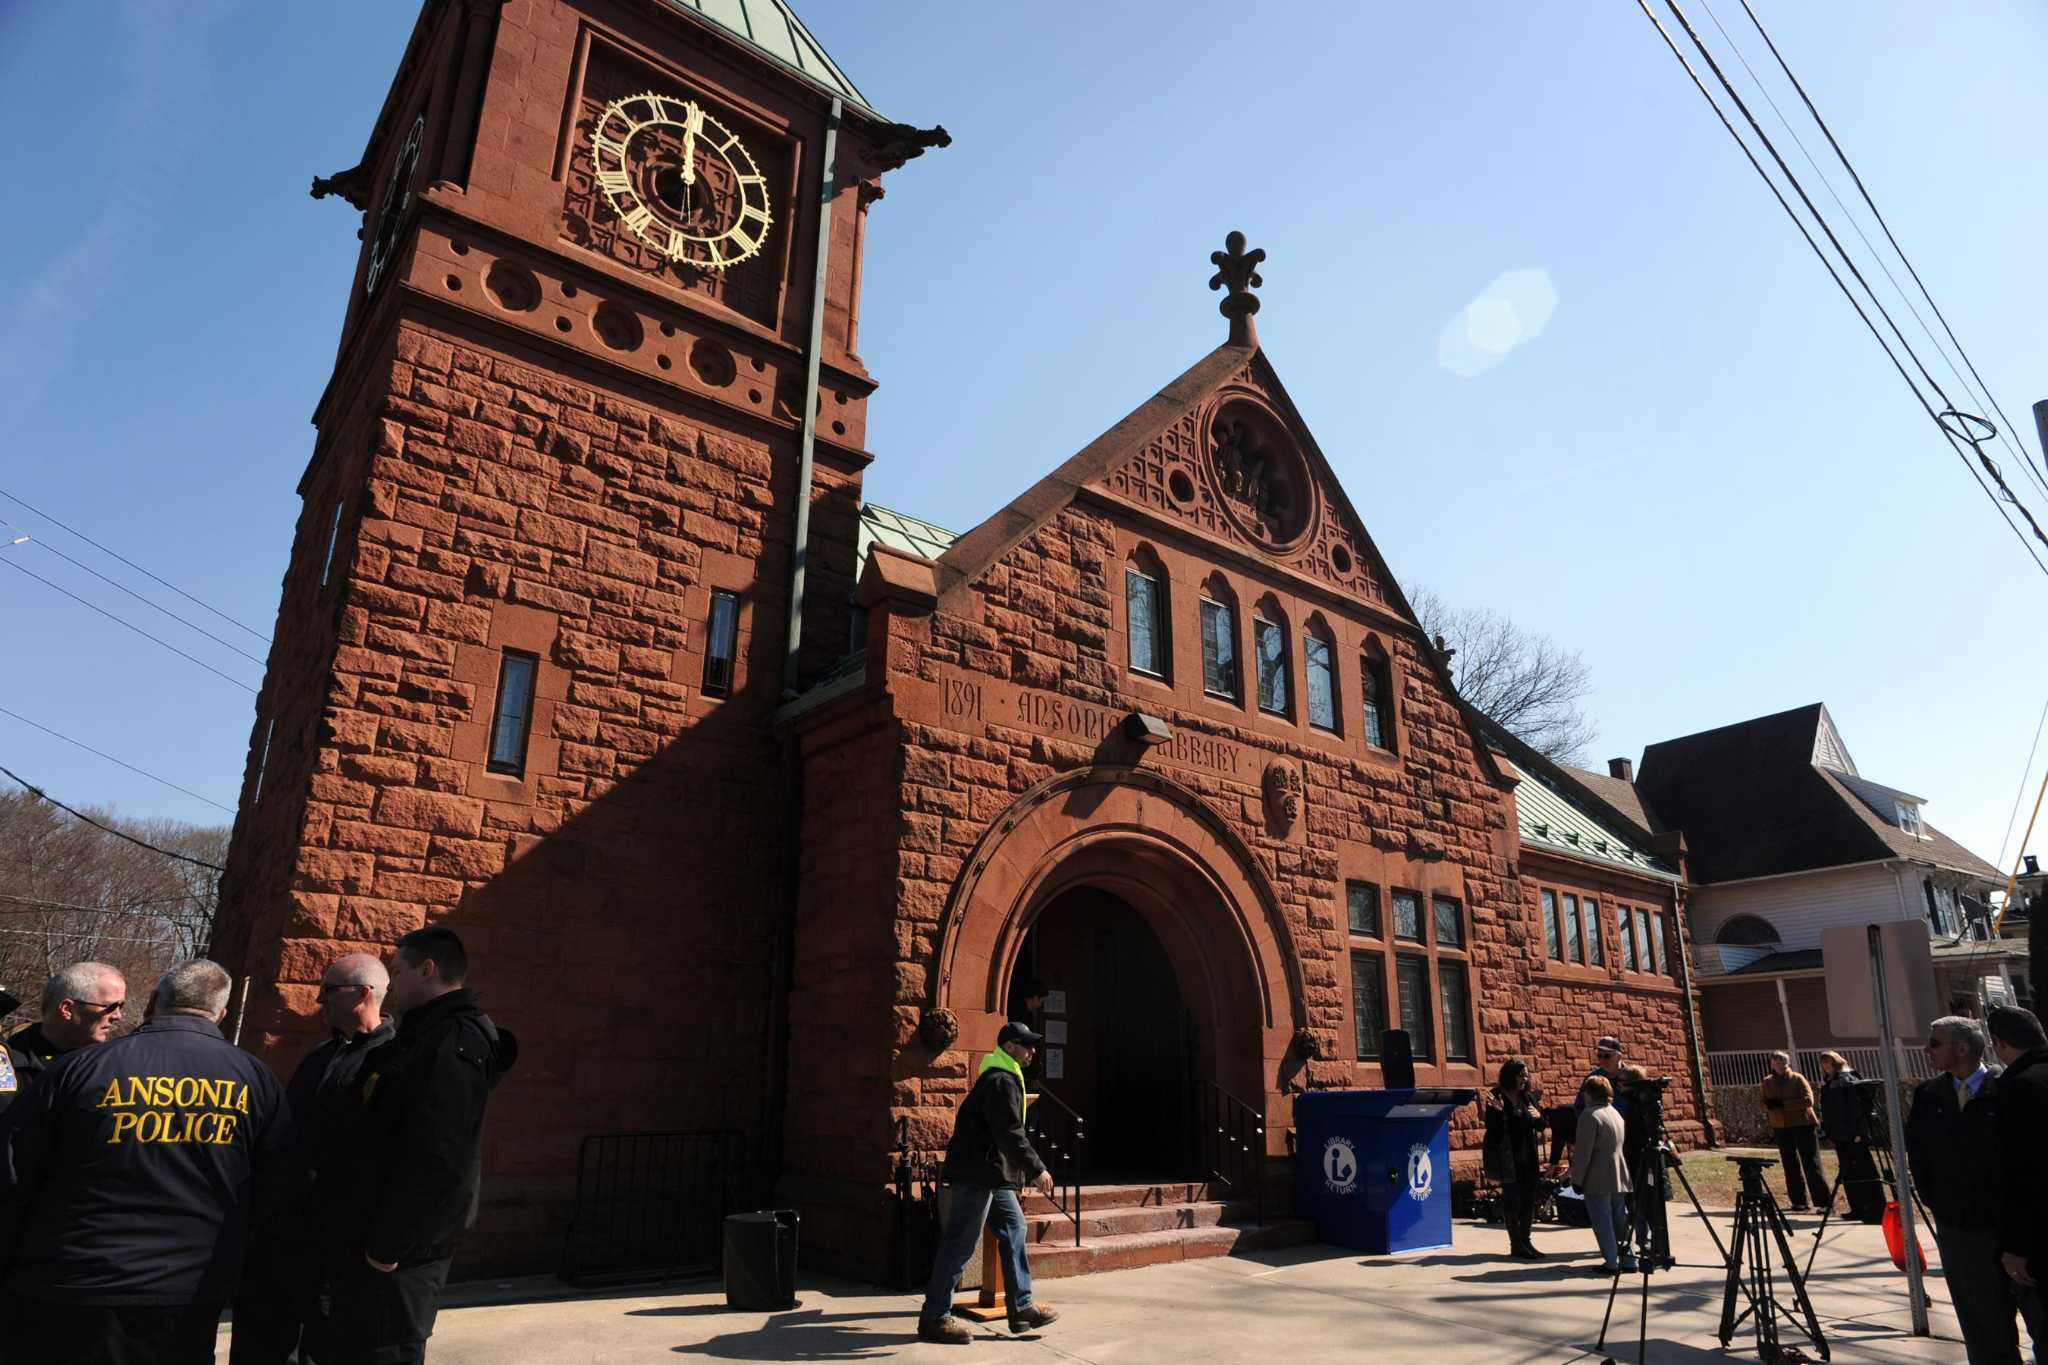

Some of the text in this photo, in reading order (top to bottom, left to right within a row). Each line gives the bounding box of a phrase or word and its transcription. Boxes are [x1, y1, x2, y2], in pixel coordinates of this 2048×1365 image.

[943, 677, 982, 722] 1891
[96, 1075, 249, 1114] ANSONIA
[107, 1110, 237, 1145] POLICE
[1323, 1136, 1356, 1150] LIBRARY
[1324, 1180, 1358, 1194] RETURN
